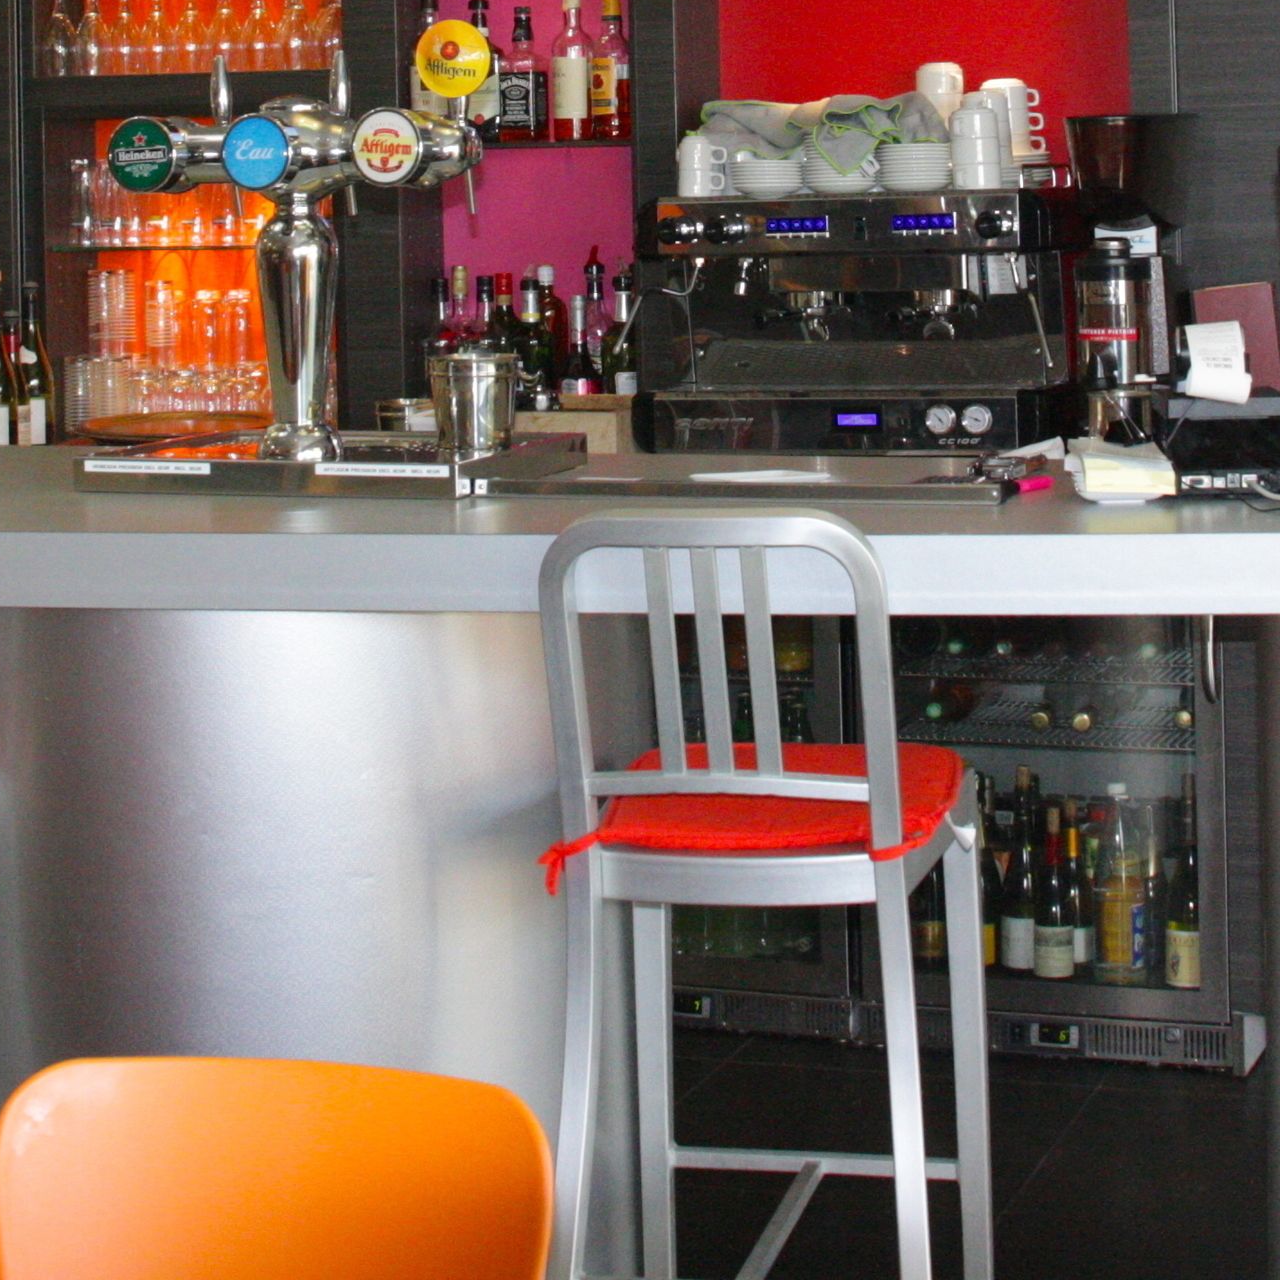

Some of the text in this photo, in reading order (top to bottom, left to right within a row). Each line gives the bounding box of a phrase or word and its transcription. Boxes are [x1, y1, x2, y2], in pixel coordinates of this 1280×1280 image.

[424, 57, 477, 80] Affligem
[117, 149, 165, 163] Heineken
[234, 138, 276, 161] Eau
[360, 136, 412, 157] Affligem
